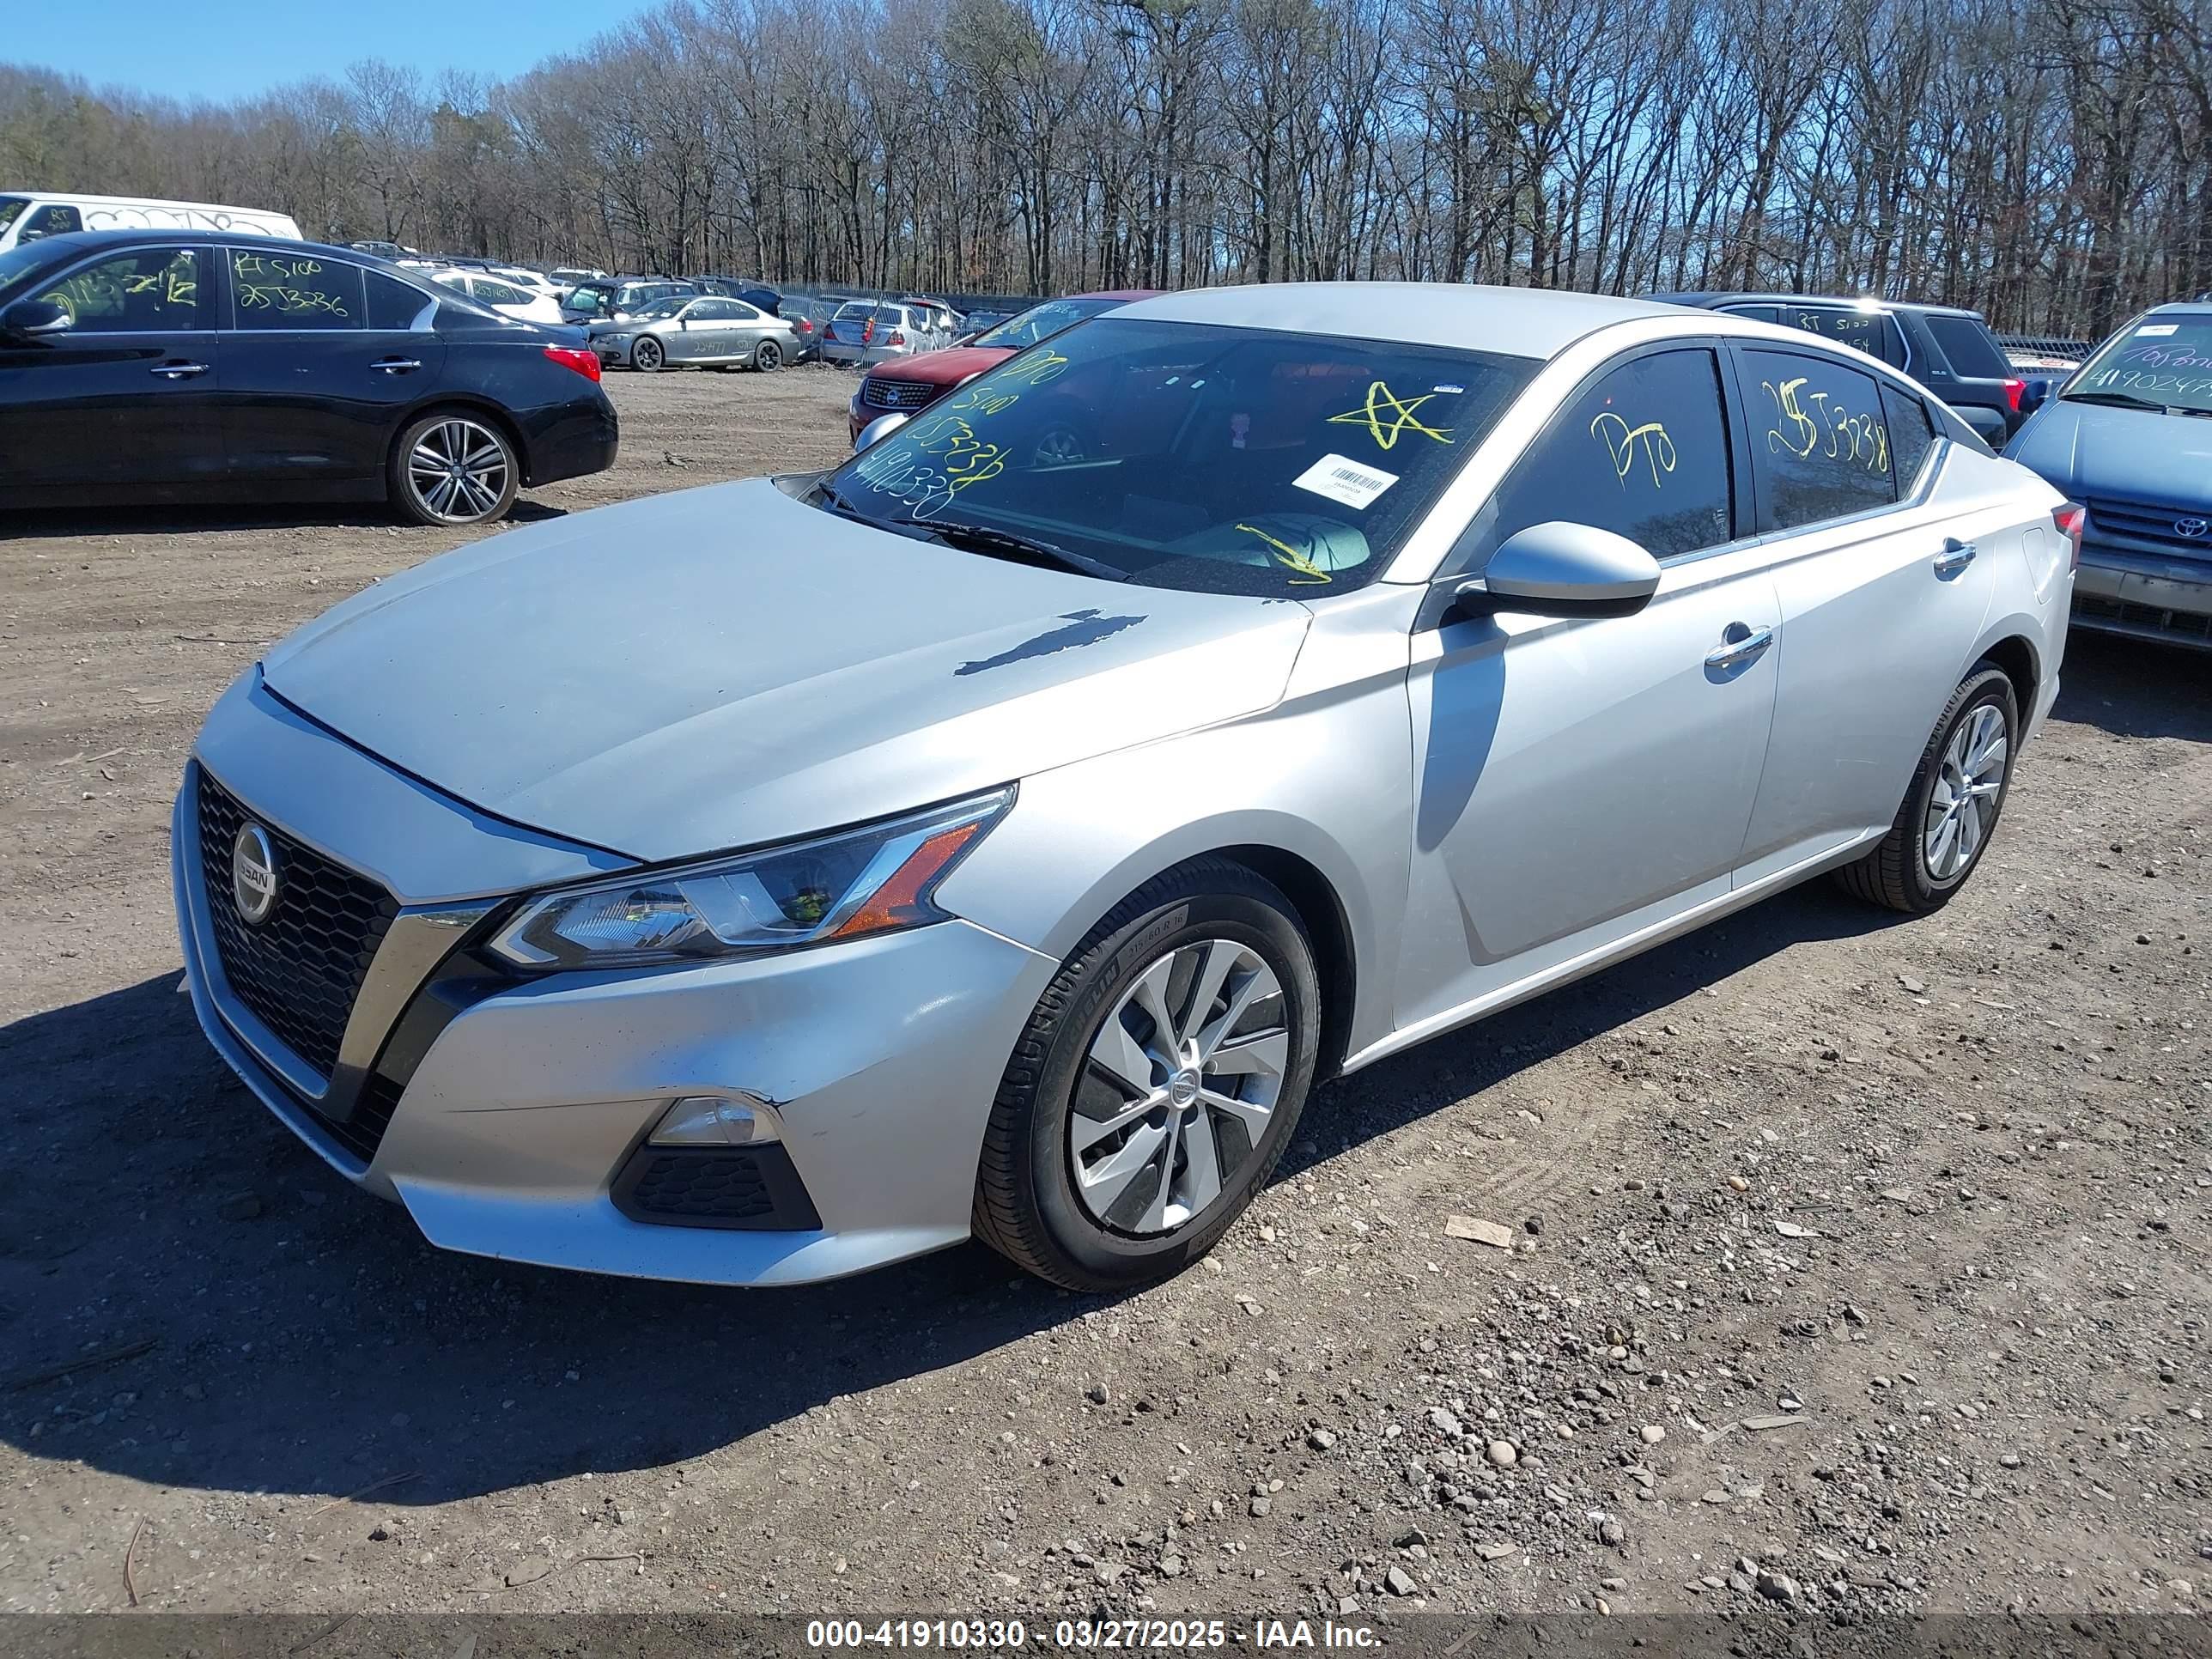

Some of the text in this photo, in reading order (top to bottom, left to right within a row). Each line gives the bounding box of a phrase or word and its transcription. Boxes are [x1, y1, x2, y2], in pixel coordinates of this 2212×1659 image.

[234, 251, 266, 278] RT
[239, 283, 349, 318] 25J3236
[1798, 313, 1820, 331] RT
[2089, 368, 2212, 398] 4190247
[240, 862, 268, 889] SSAN
[1164, 920, 1170, 931] R
